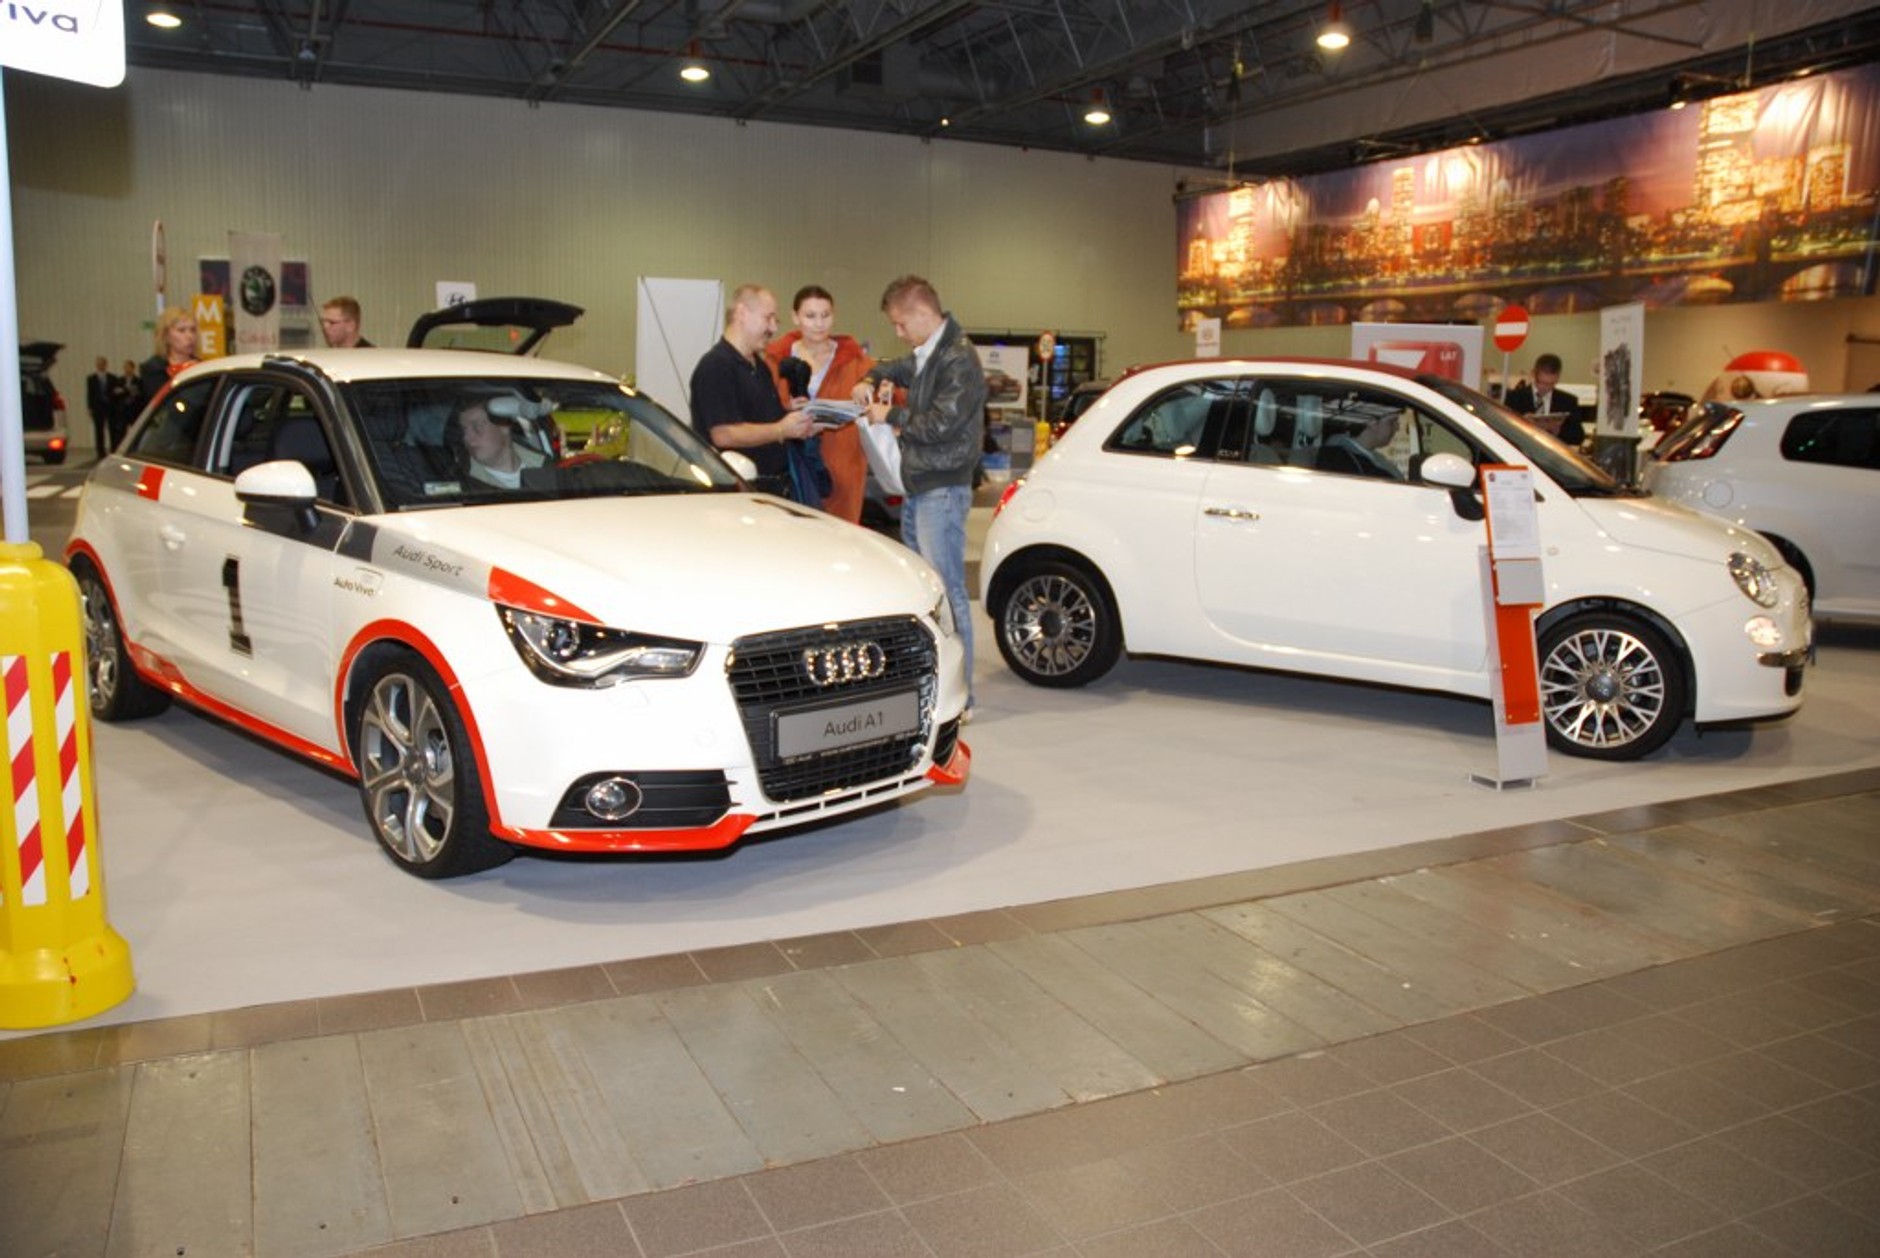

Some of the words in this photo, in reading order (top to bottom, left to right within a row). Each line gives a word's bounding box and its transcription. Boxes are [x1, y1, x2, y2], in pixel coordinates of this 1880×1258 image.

[0, 0, 78, 34] iva
[393, 545, 424, 562] Audi
[423, 555, 463, 577] Sport
[222, 555, 253, 658] 1
[823, 717, 862, 737] Audi
[865, 711, 884, 728] A1
